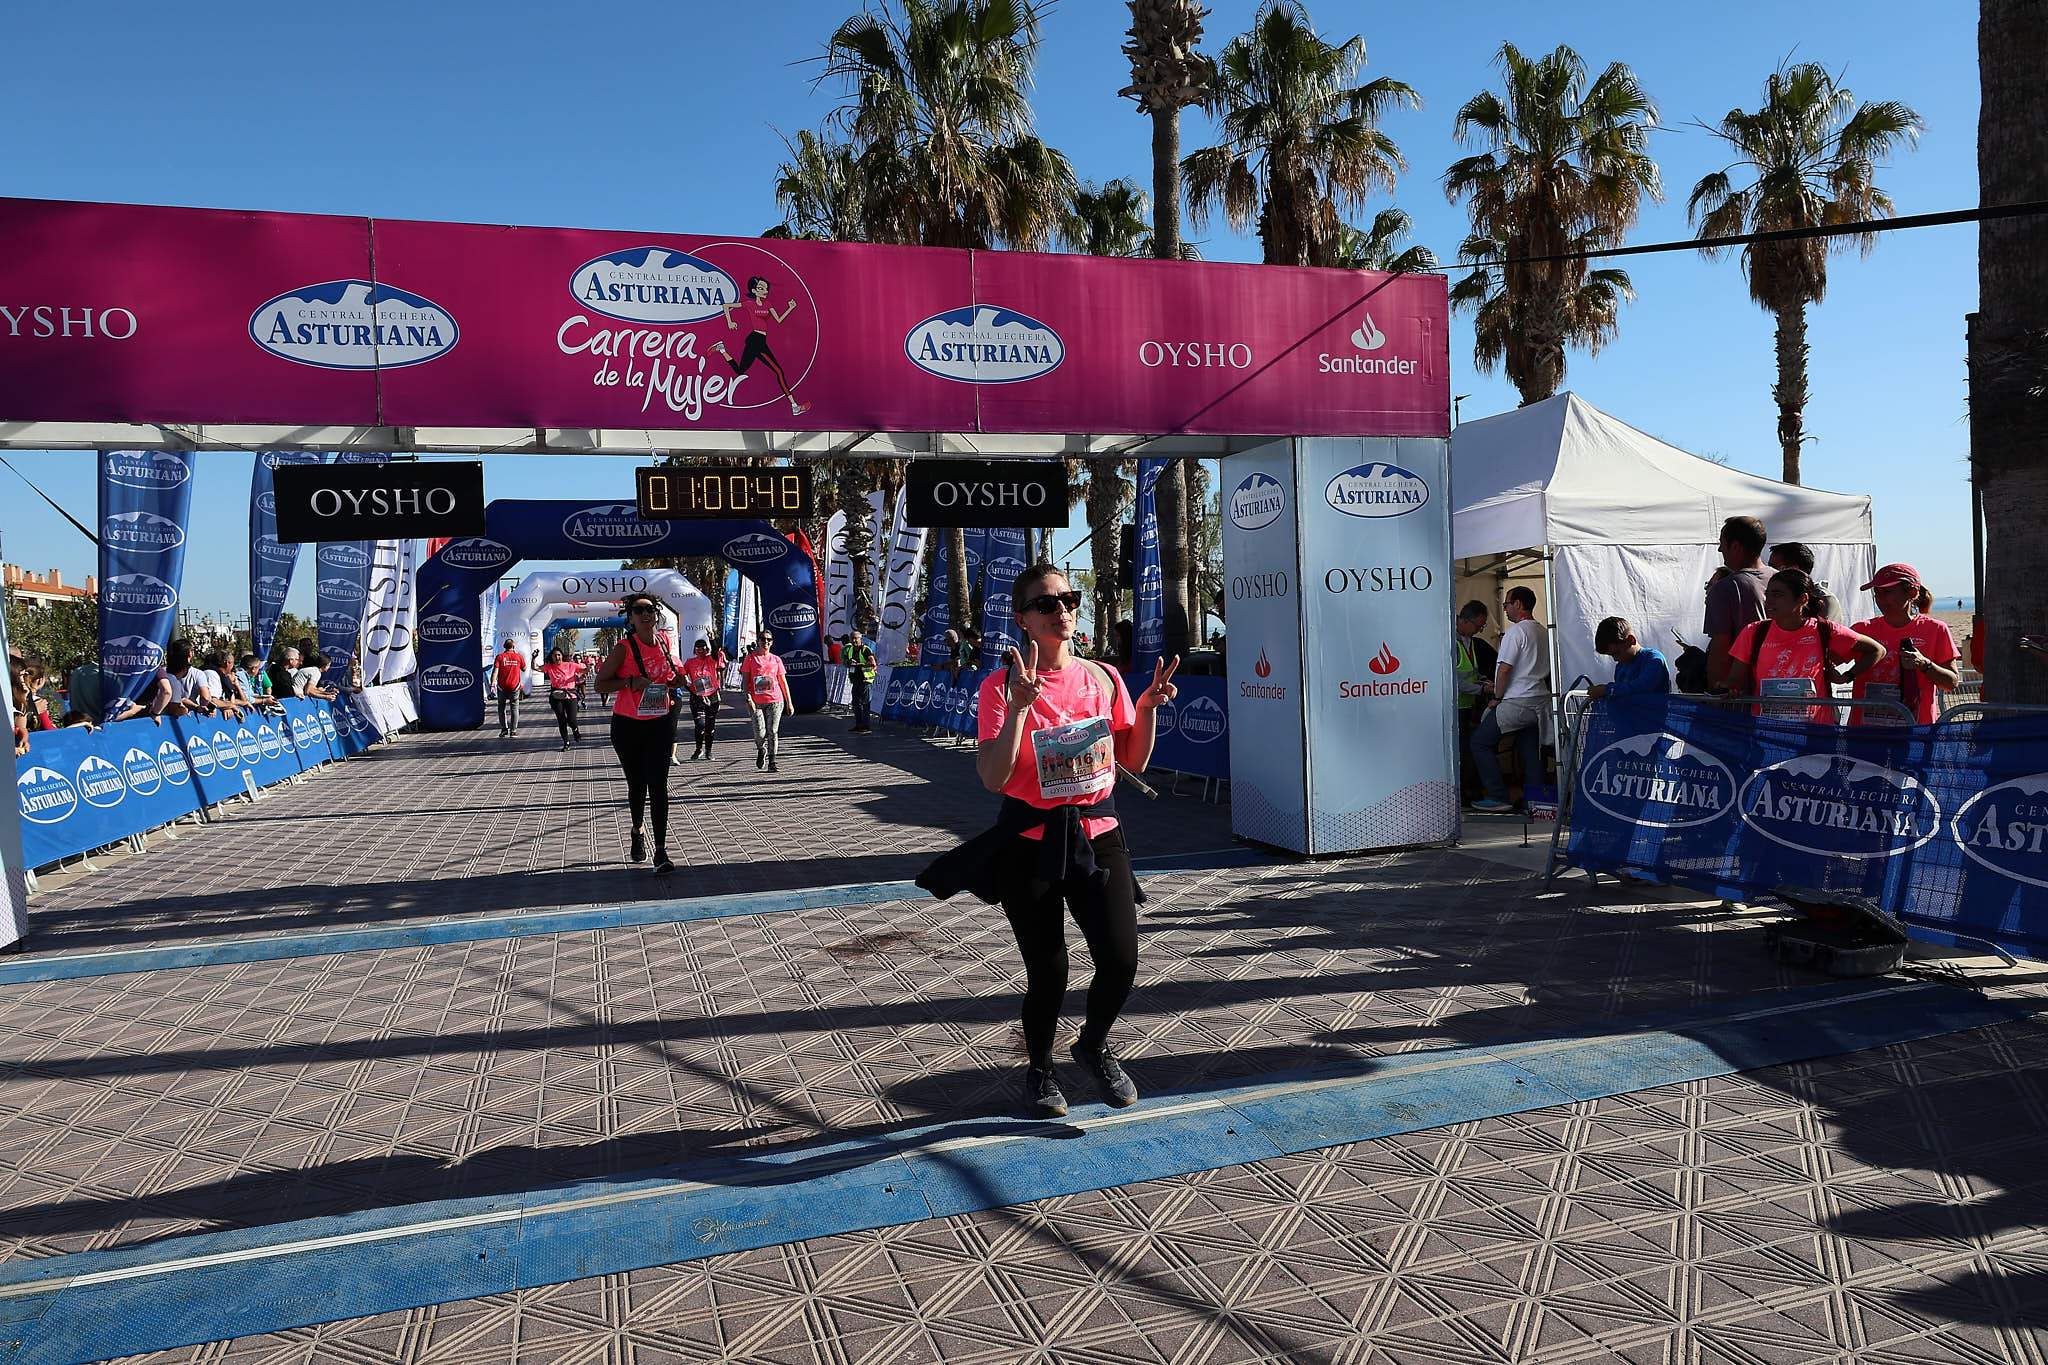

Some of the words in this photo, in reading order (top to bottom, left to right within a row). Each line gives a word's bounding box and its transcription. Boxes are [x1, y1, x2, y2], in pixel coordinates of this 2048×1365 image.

[610, 271, 663, 281] CENTRAL
[668, 274, 720, 284] LECHERA
[584, 272, 726, 306] ASTURIANA
[298, 310, 364, 320] CENTRAL
[266, 311, 444, 346] ASTURIANA
[557, 316, 697, 359] Carrera
[942, 331, 991, 340] CENTRAL
[997, 332, 1047, 341] LECHERA
[918, 332, 1053, 364] ASTURIANA
[1139, 341, 1252, 369] OYSHO
[1319, 353, 1418, 375] Santander
[594, 359, 619, 386] de
[626, 360, 644, 387] la
[641, 356, 749, 421] Mujer
[310, 488, 456, 517] OYSHO
[933, 480, 1046, 507] OYSHO
[1333, 483, 1422, 504] ASTURIANA
[1233, 496, 1281, 520] ASTURIANA
[572, 518, 664, 537] ASTURIANA
[446, 550, 506, 560] ASTURIANA
[728, 546, 784, 556] ASTURIANA
[562, 576, 647, 595] OYSHO
[1232, 572, 1288, 600] OYSHO
[1324, 566, 1432, 594] OYSHO
[422, 624, 469, 636] ASTURIANA
[422, 675, 470, 686] ASTURIANA
[1240, 681, 1286, 700] Santander
[1340, 678, 1428, 698] Santander
[127, 767, 160, 786] ASTURIANA
[1616, 760, 1664, 773] CENTRAL
[82, 777, 124, 798] ASTURIANA
[1590, 760, 1721, 810] ASTURIANA
[1782, 780, 1844, 798] CENTRAL
[20, 791, 74, 814] ASTURIANA
[1750, 779, 1920, 838] ASTURIANA
